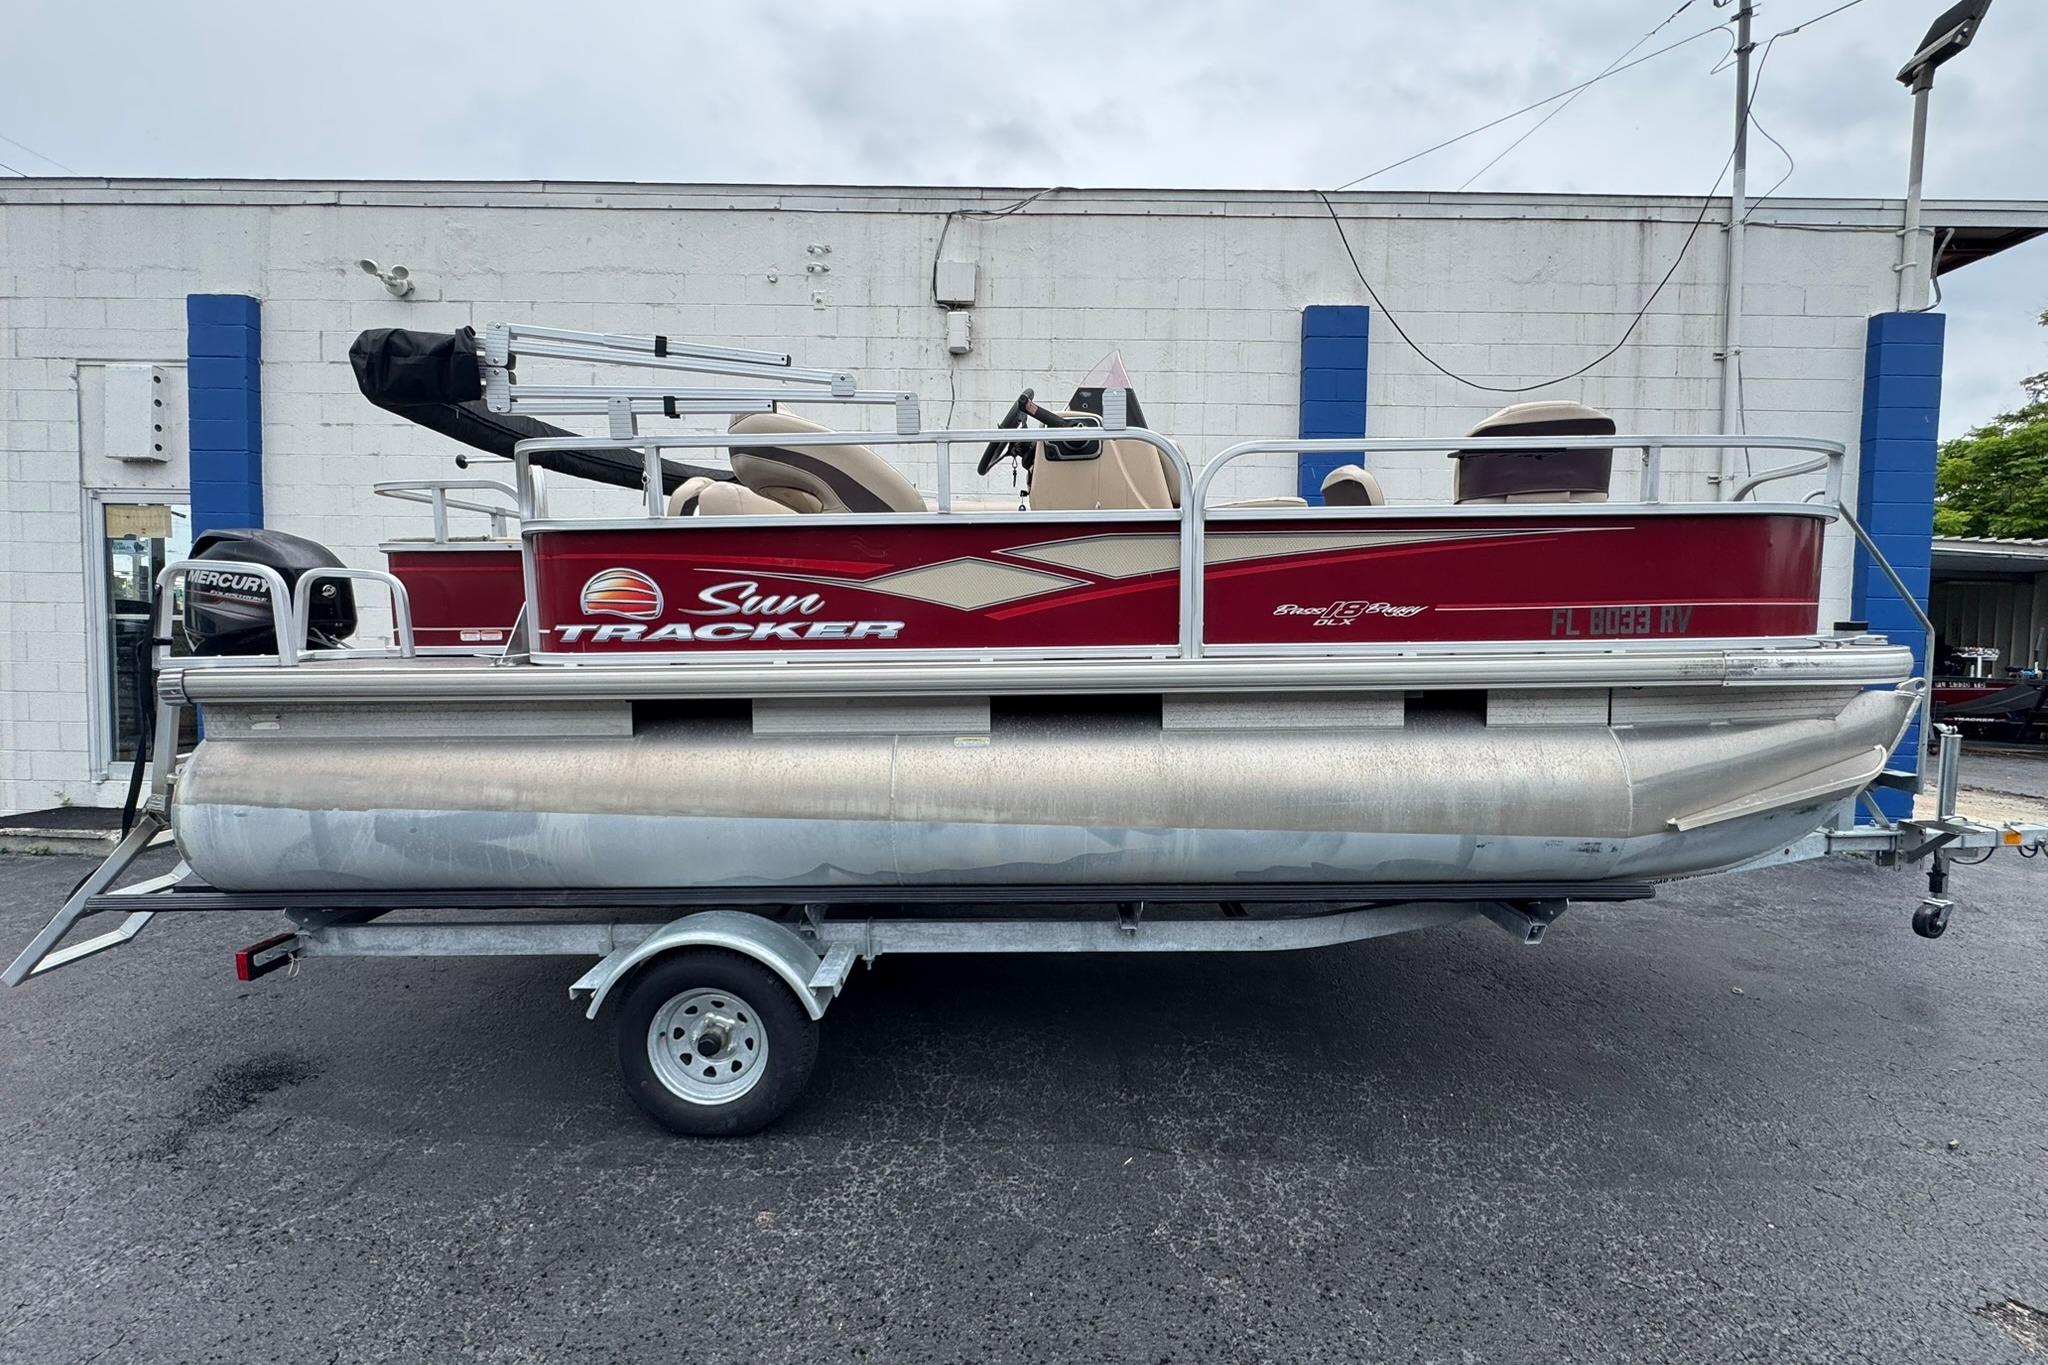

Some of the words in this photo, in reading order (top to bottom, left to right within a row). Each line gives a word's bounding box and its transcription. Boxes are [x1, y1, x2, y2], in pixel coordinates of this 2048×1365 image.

[188, 570, 270, 593] MERCURY
[677, 581, 826, 616] Sun
[1273, 603, 1327, 616] Bass
[1320, 600, 1370, 619] 18
[1365, 602, 1430, 618] Buggy
[1312, 618, 1356, 627] DLX
[1551, 607, 1580, 635] FL
[1660, 605, 1694, 633] RV
[554, 621, 905, 643] TRACKER
